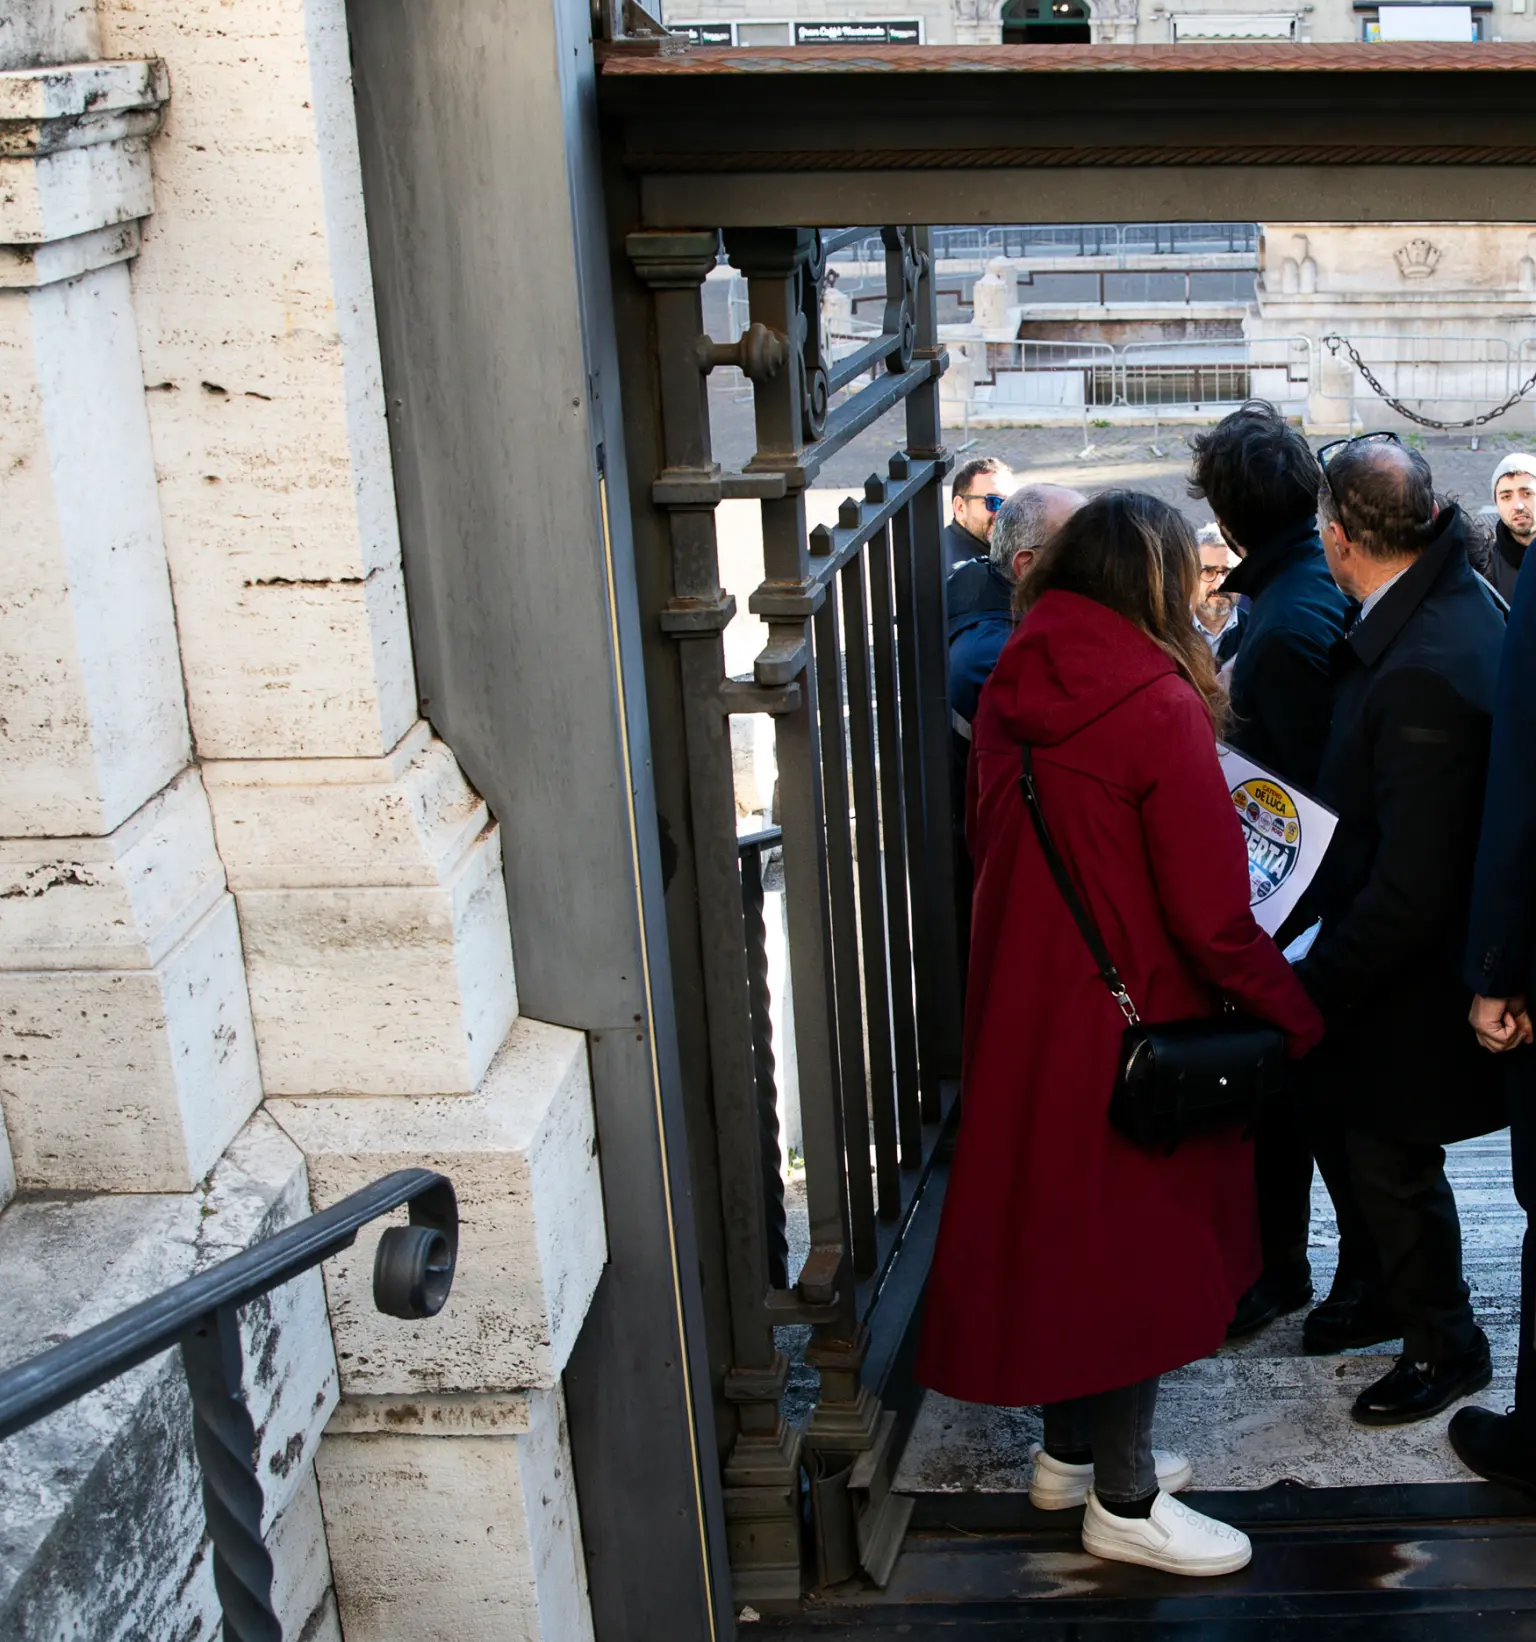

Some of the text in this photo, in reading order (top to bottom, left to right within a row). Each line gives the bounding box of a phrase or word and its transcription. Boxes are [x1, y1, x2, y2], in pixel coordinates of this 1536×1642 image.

[1255, 788, 1266, 802] DE
[1266, 794, 1286, 815] LUCA
[1161, 1494, 1240, 1542] BOGNER
